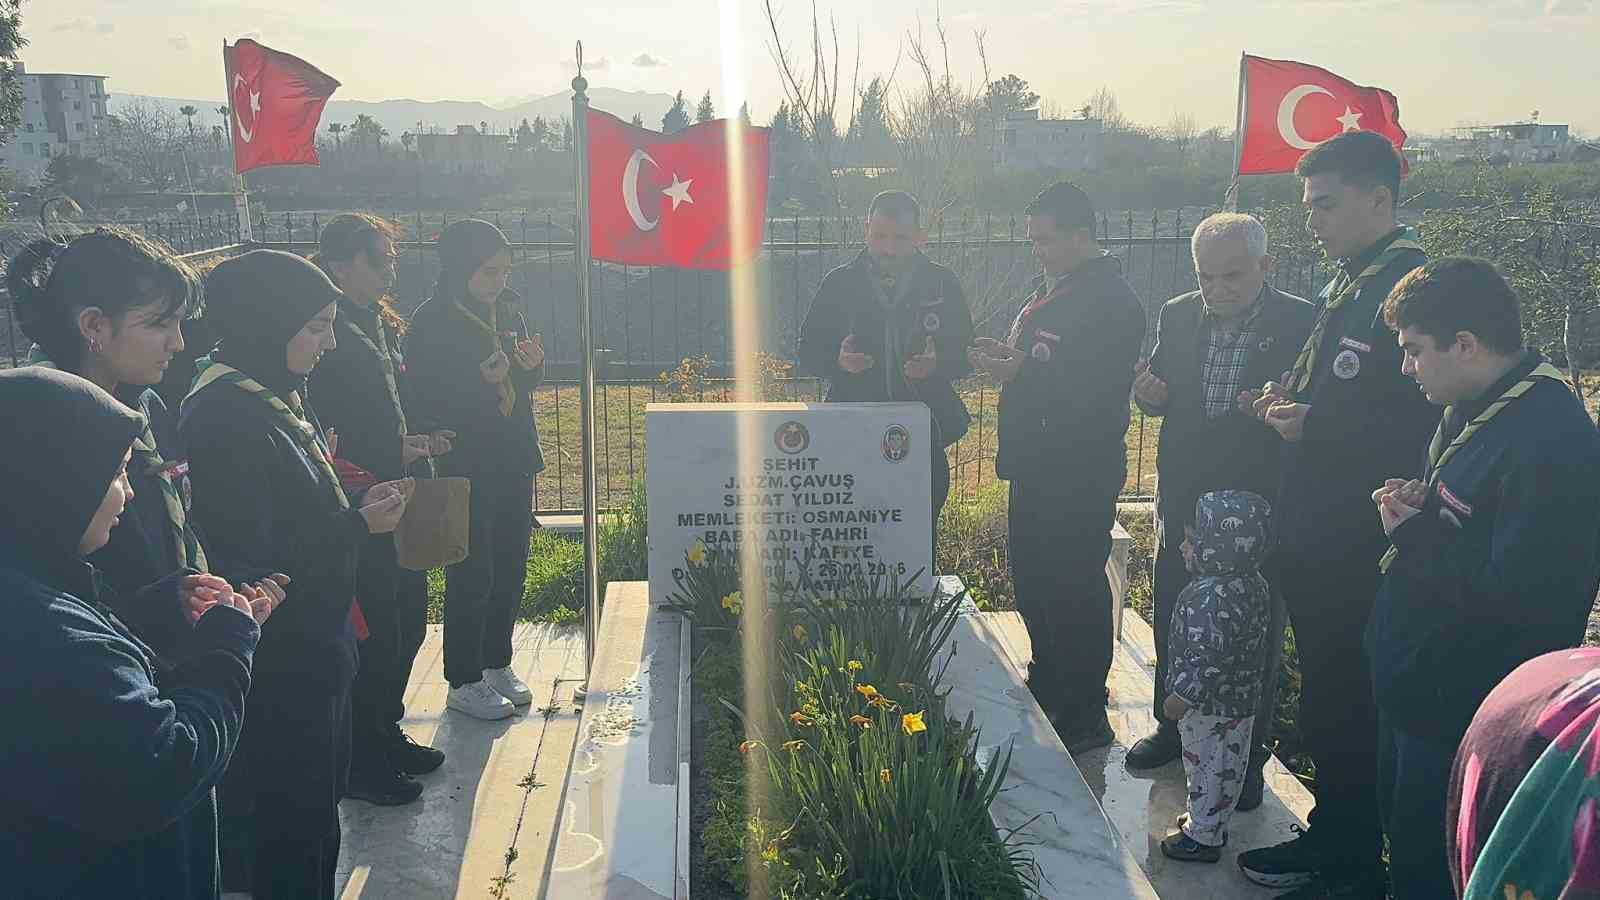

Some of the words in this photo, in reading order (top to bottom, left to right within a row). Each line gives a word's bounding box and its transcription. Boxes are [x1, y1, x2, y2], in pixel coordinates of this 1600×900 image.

[723, 493, 785, 508] SEDAT
[791, 491, 854, 507] YILDIZ
[704, 529, 759, 543] BABA
